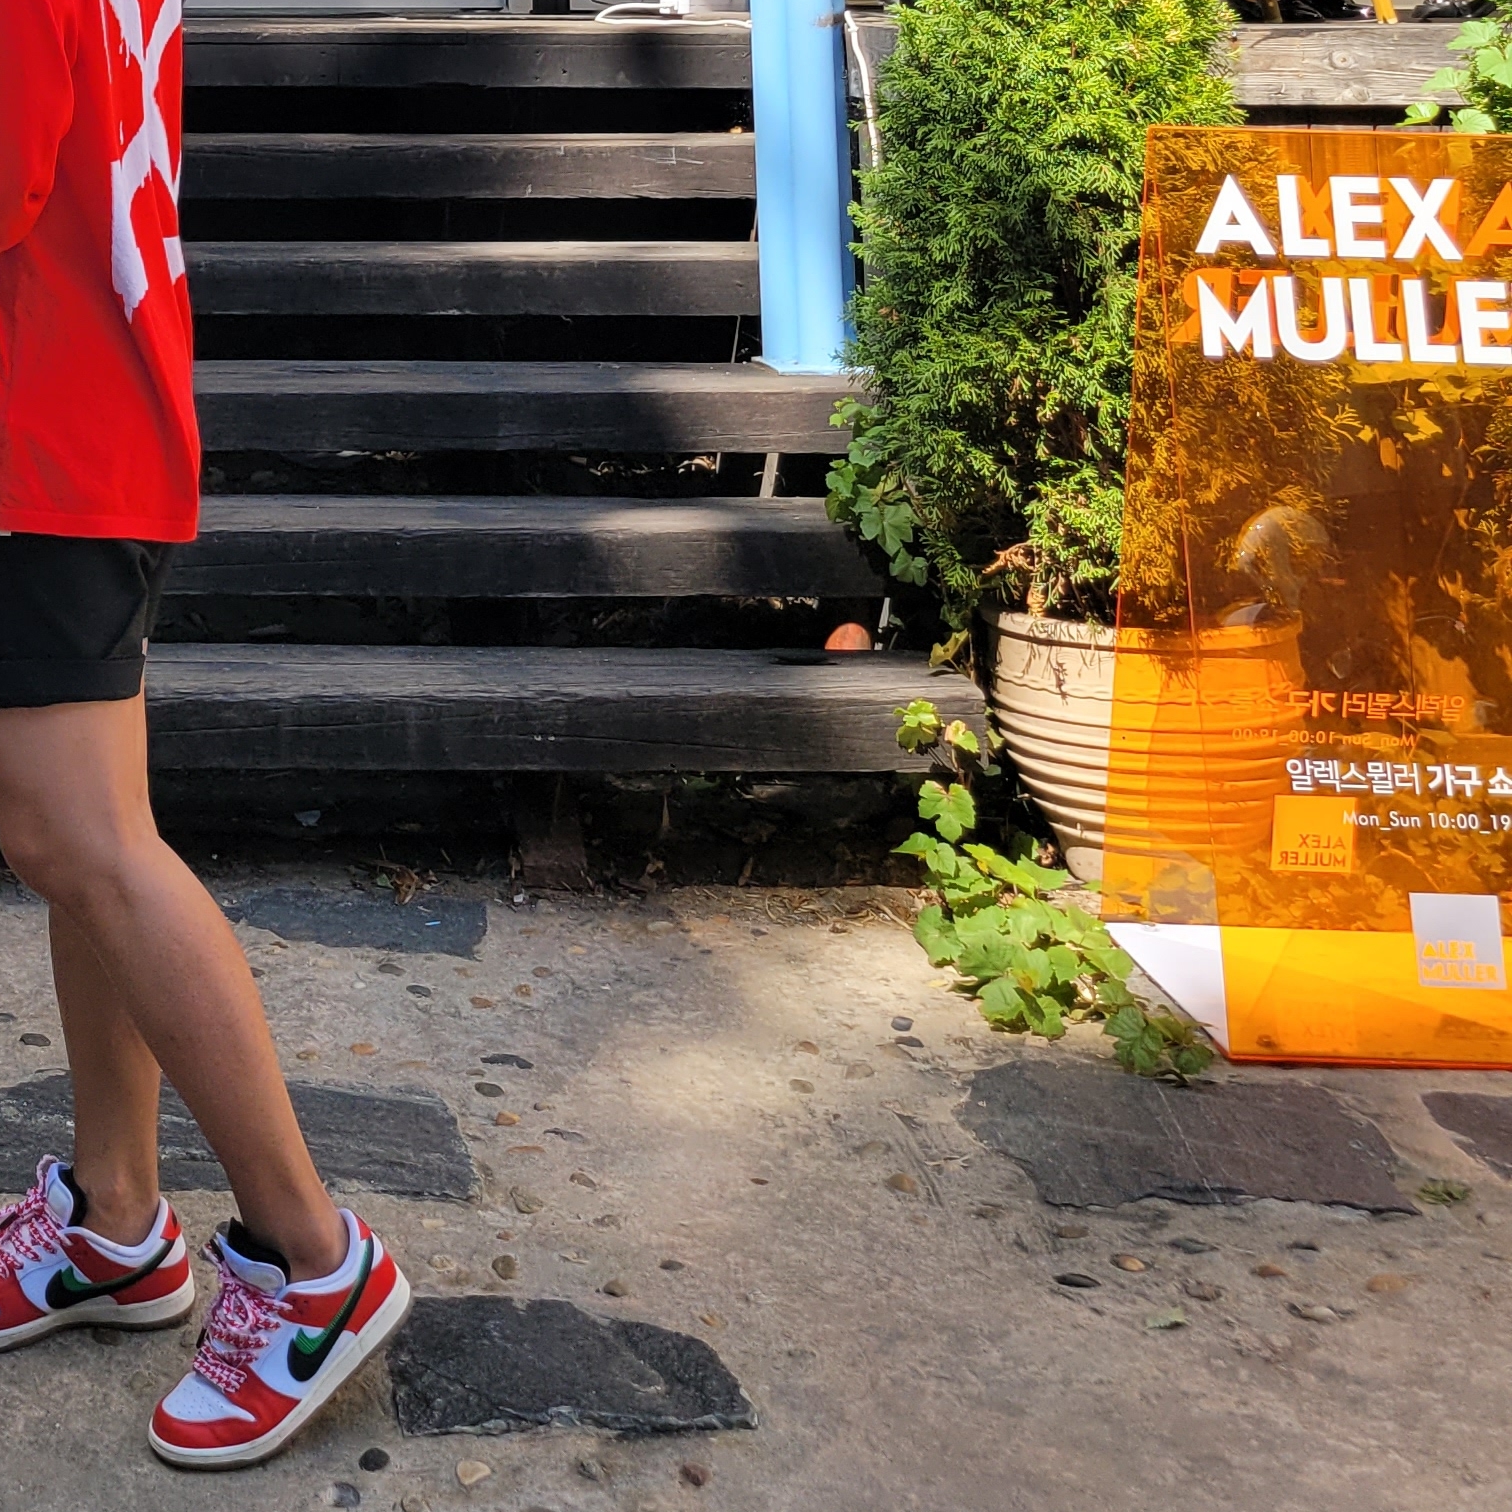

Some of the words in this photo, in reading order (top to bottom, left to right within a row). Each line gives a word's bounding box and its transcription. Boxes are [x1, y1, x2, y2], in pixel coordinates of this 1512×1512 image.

[1195, 173, 1464, 261] ALEX
[1197, 275, 1512, 365] MULLE
[1286, 758, 1421, 796] 알렉스뮐러
[1428, 763, 1483, 797] 가구
[1343, 810, 1421, 831] Mon_Sun
[1422, 939, 1475, 960] ALEX
[1422, 963, 1498, 983] MULLER
